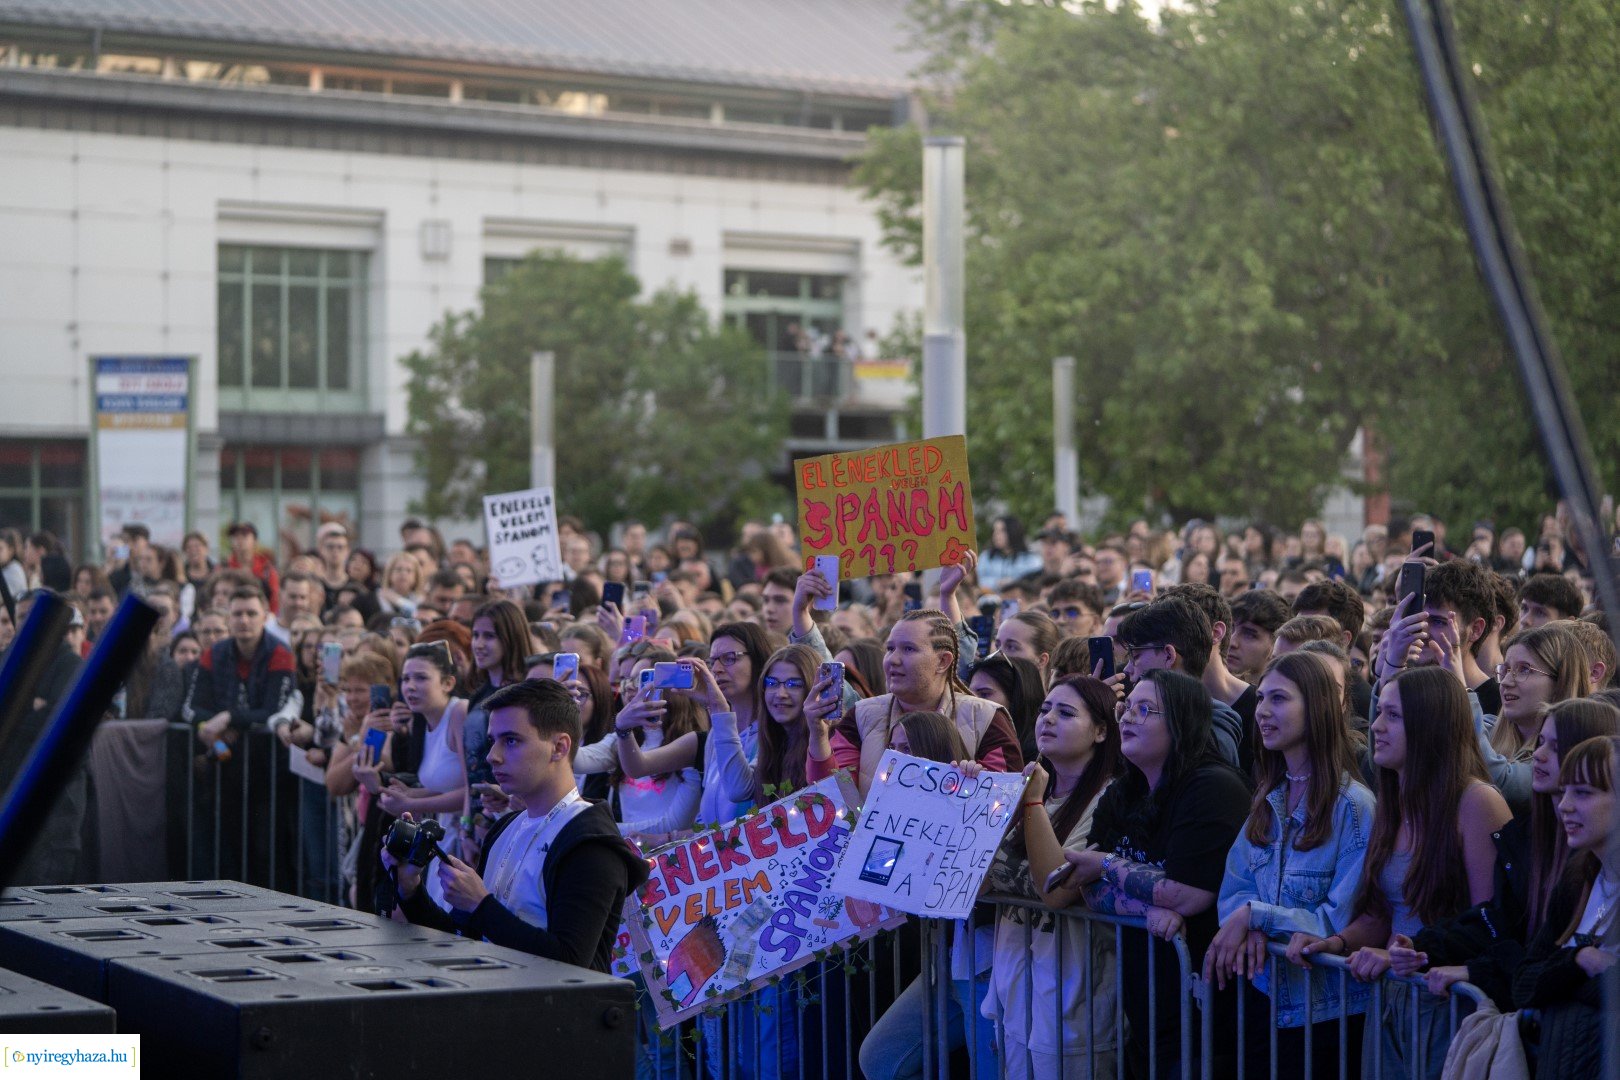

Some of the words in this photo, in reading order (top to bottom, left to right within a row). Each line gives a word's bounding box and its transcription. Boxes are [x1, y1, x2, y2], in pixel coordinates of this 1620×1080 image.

[802, 462, 827, 490] EL
[939, 470, 951, 484] A
[501, 512, 545, 528] VELEM
[804, 481, 967, 549] SPANOM
[496, 525, 549, 544] SPANOM
[897, 762, 995, 800] CSODA
[758, 823, 851, 963] SPANOM
[893, 873, 912, 896] A
[654, 870, 773, 938] VELEM
